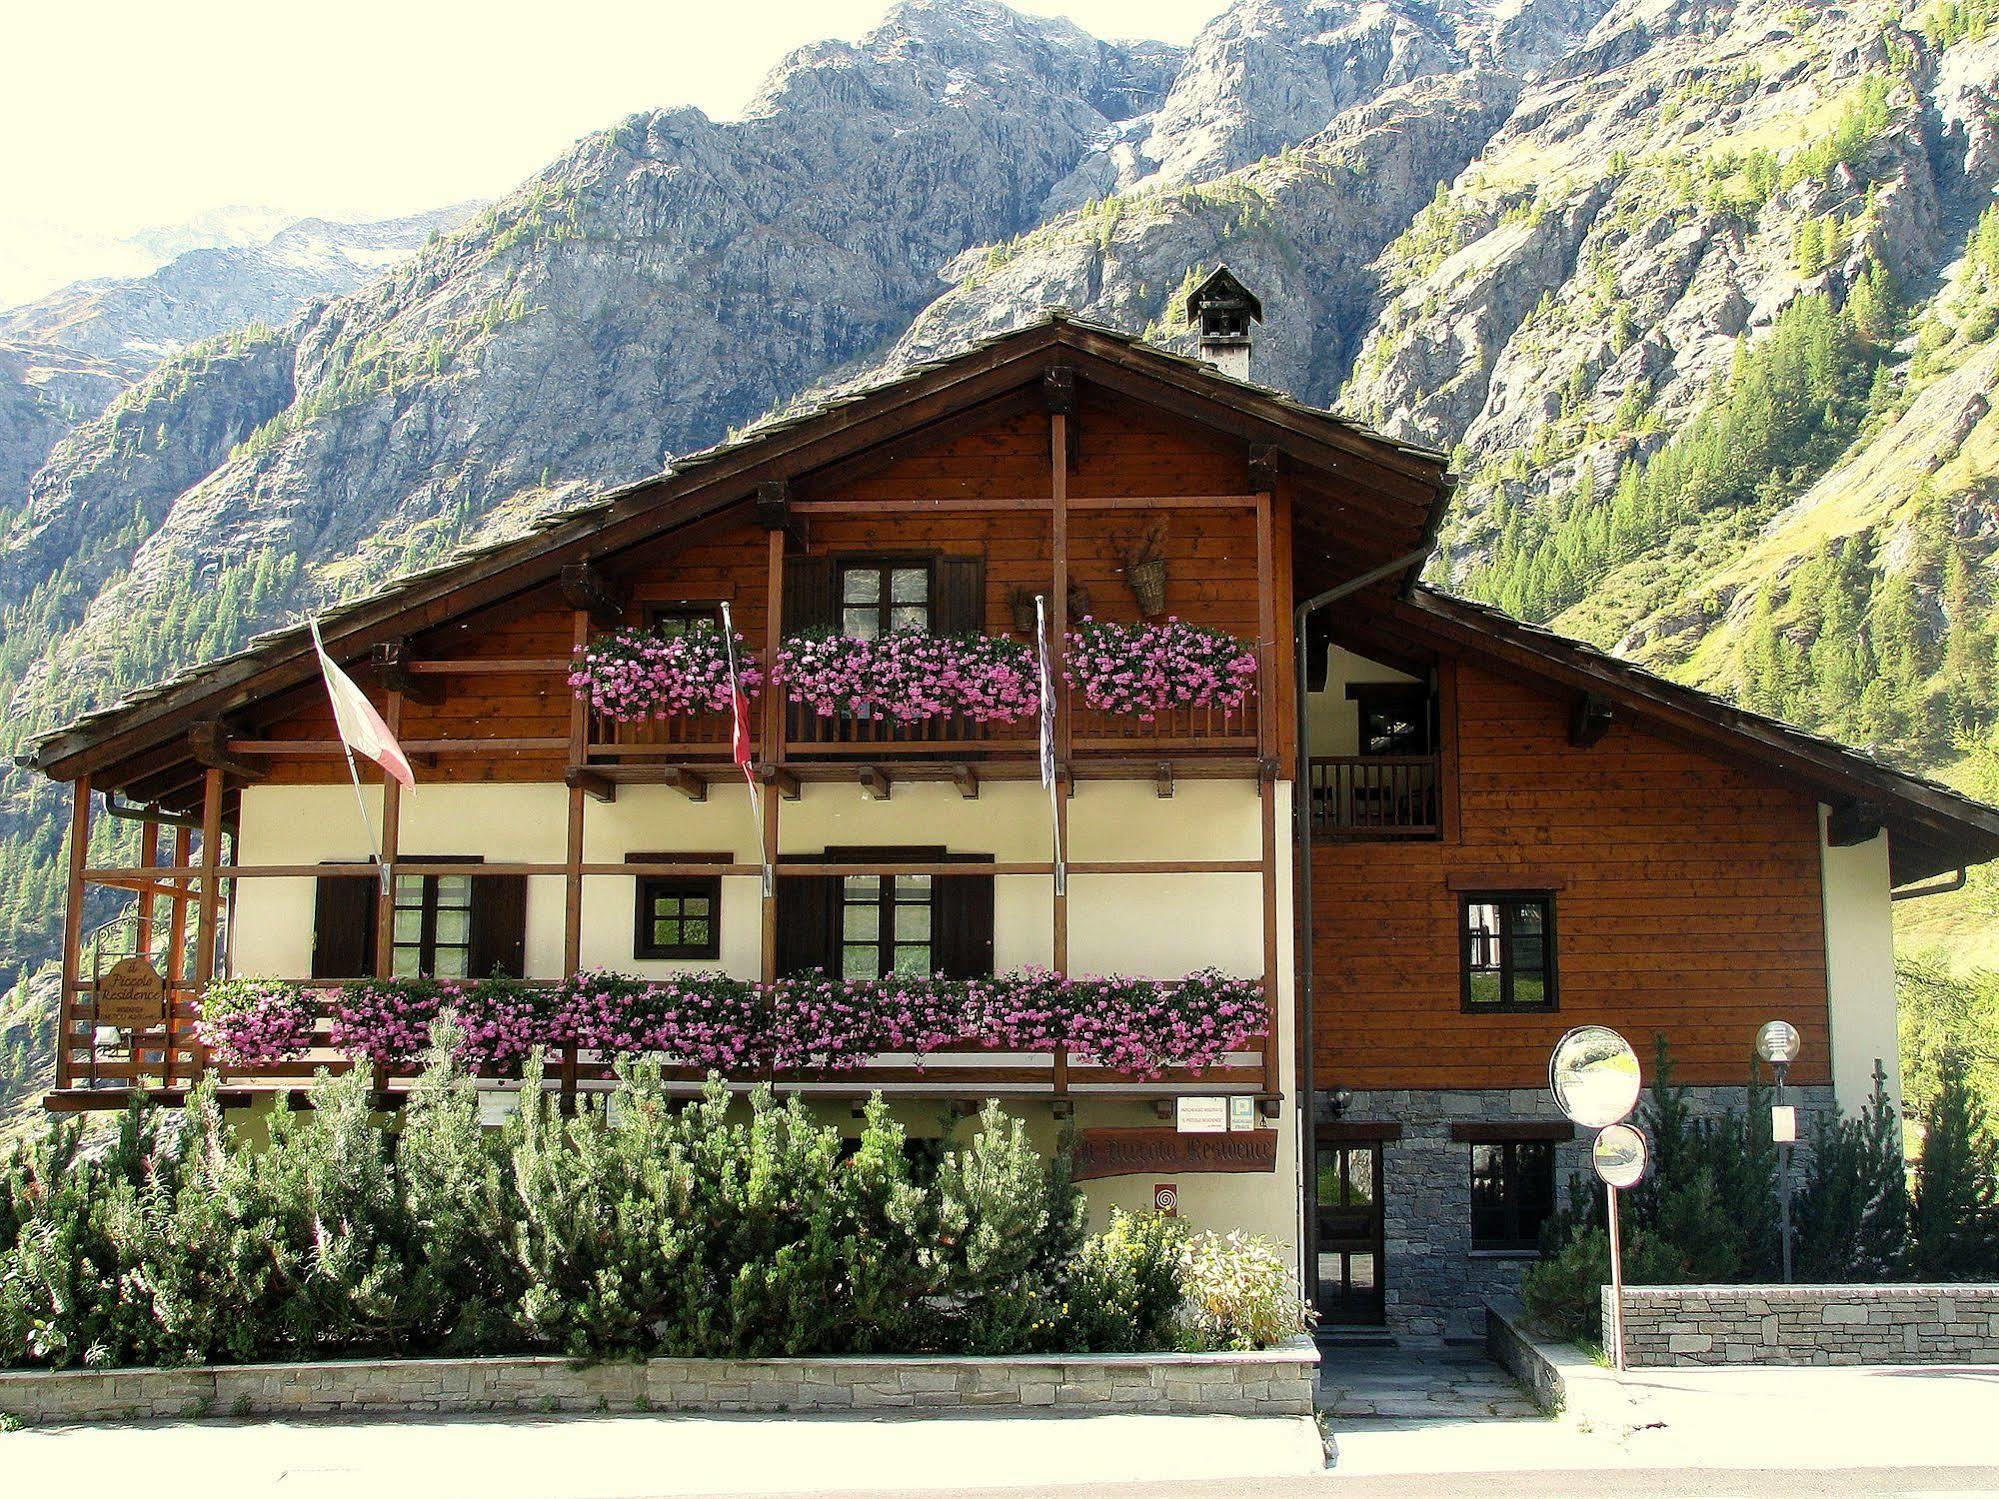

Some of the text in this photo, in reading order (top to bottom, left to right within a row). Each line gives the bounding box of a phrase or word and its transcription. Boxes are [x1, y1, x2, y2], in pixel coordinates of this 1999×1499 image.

[113, 973, 153, 987] Piccolo
[102, 987, 162, 1000] Residence
[1184, 1136, 1272, 1161] Residence
